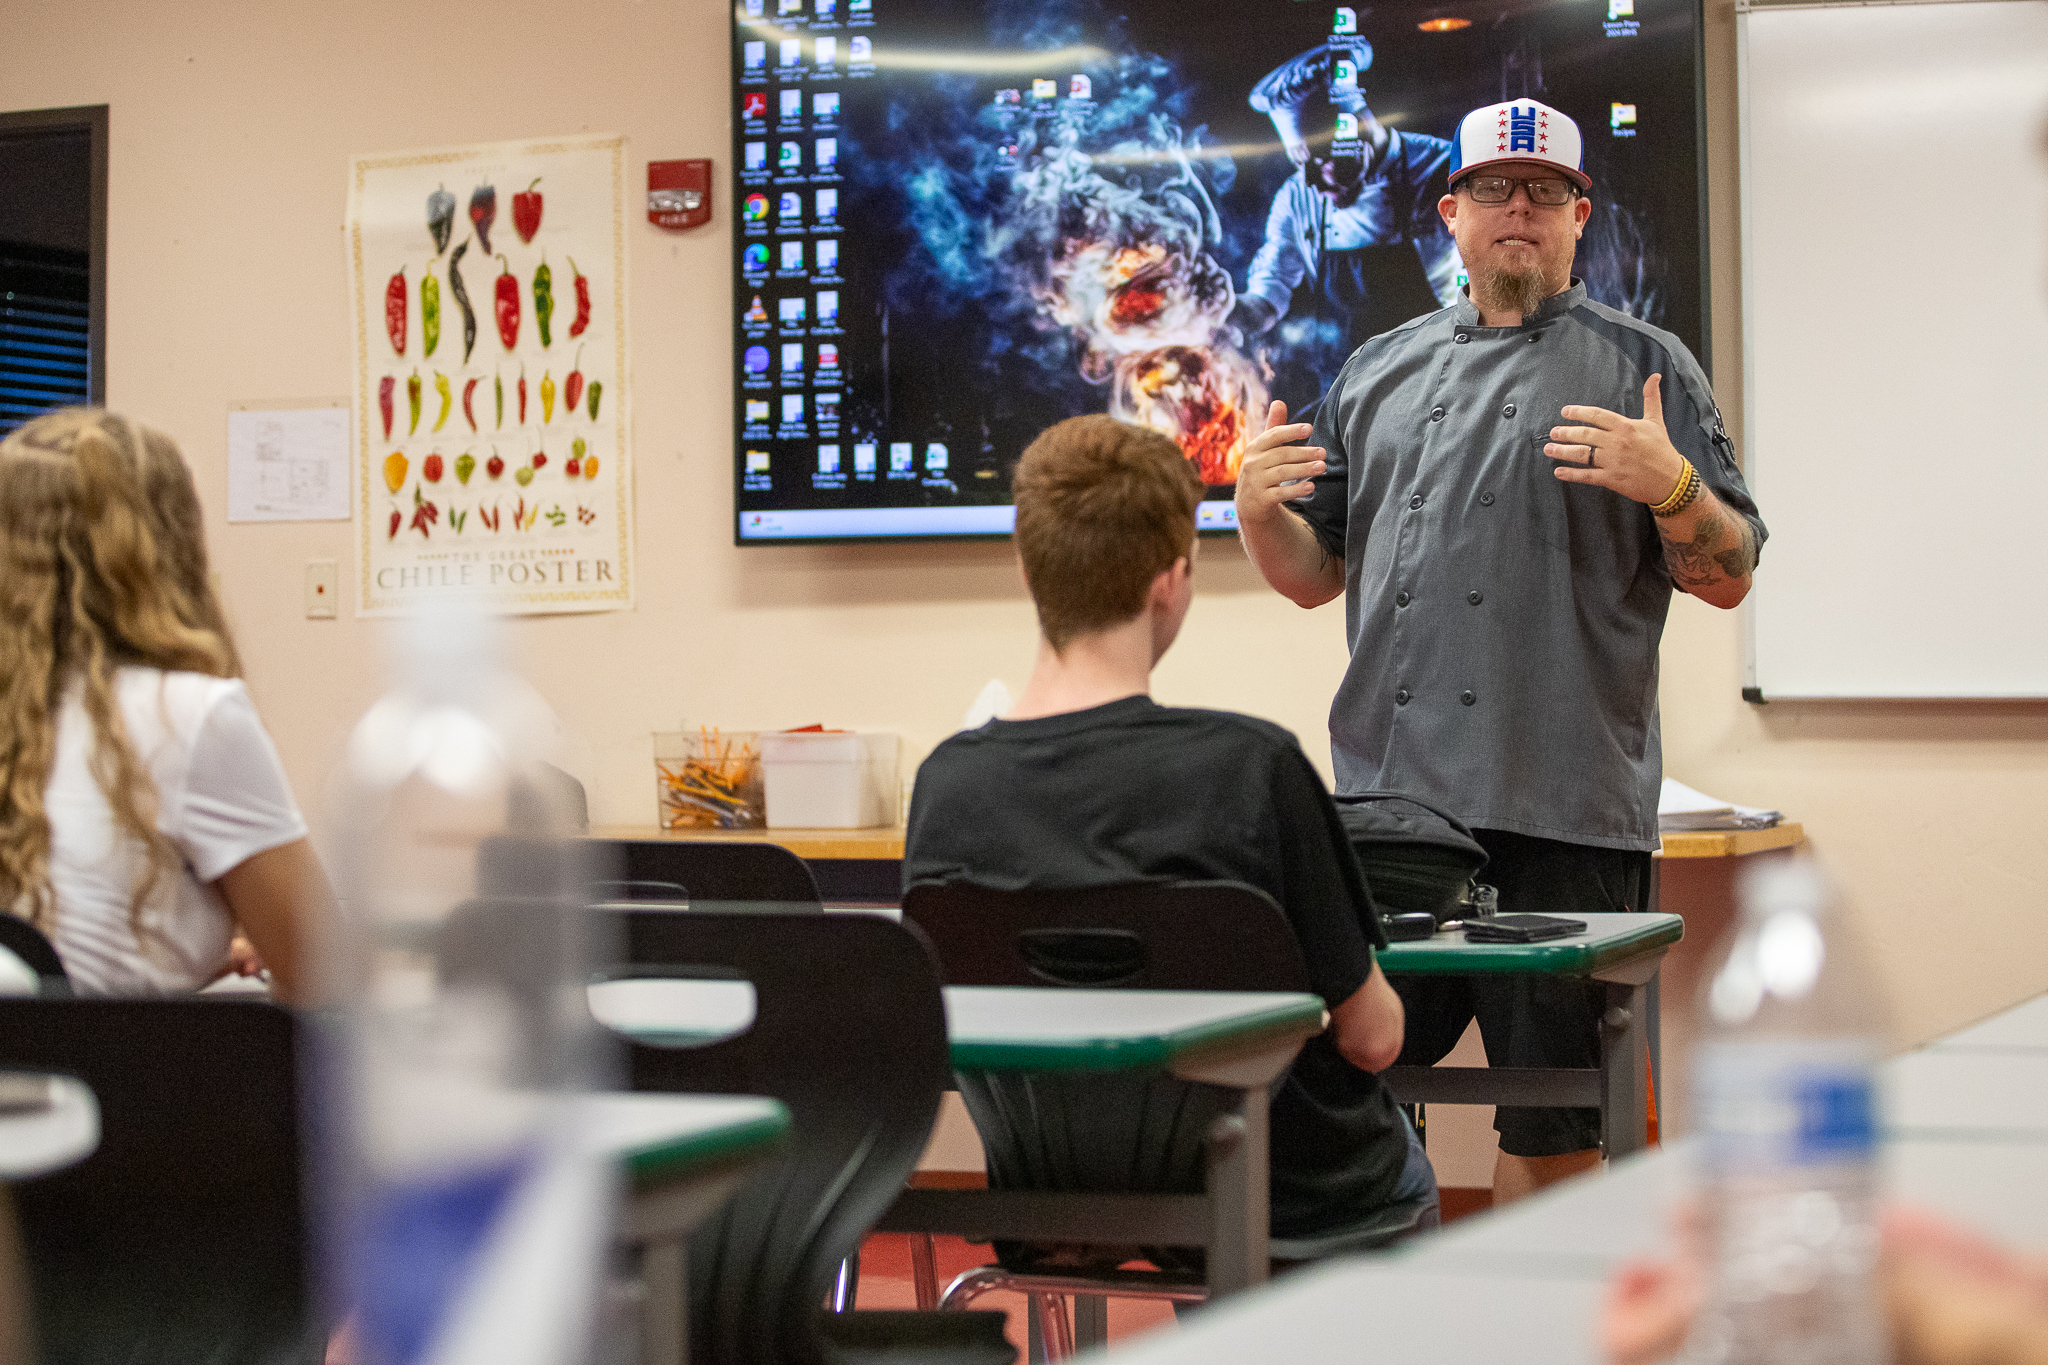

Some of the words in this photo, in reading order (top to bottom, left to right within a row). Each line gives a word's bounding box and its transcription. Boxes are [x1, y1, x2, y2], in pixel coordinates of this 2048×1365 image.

[1511, 106, 1535, 152] USA
[377, 565, 473, 590] CHILE
[490, 559, 613, 584] POSTER
